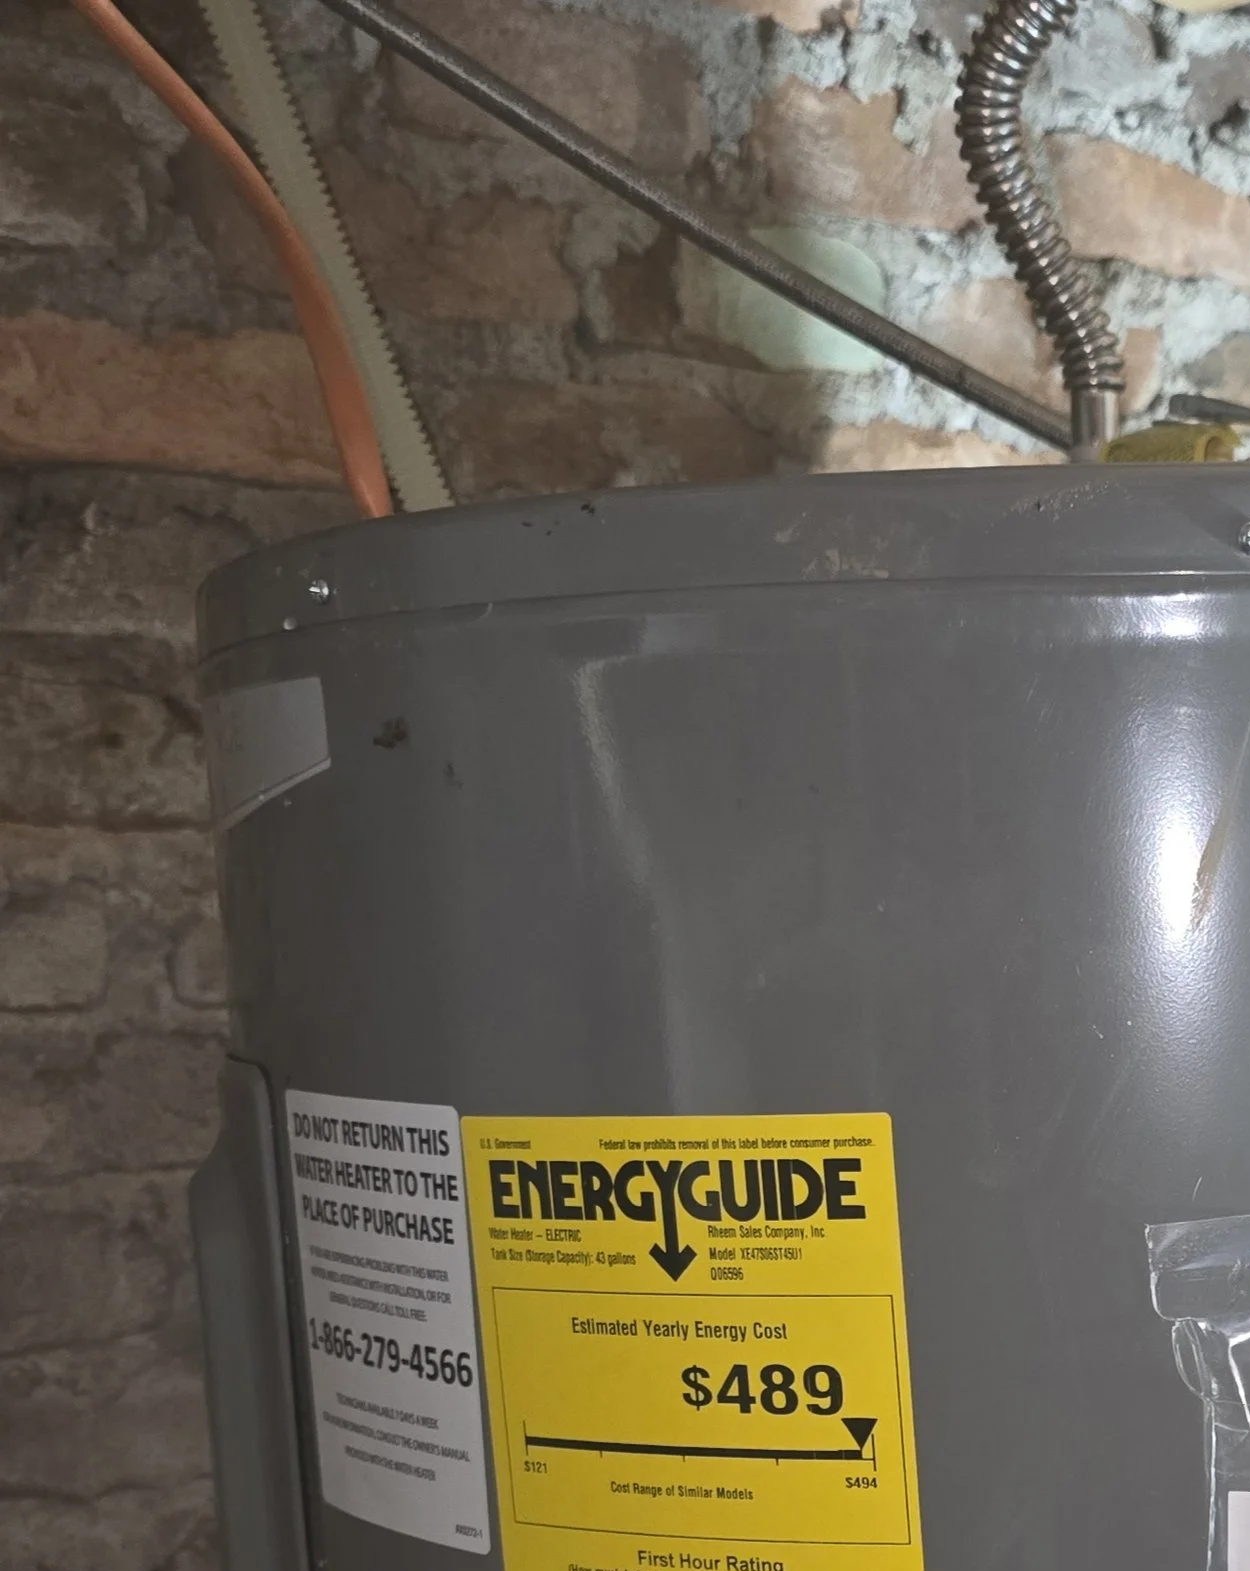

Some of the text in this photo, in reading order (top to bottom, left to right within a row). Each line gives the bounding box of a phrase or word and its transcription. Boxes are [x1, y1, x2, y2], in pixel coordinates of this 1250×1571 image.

[293, 1113, 449, 1157] DO NOT RETURN THIS
[599, 1139, 625, 1150] Federal
[628, 1139, 641, 1149] law
[644, 1139, 676, 1150] prohibits
[678, 1139, 709, 1150] removal
[712, 1139, 720, 1149] of
[722, 1139, 736, 1148] this
[739, 1138, 758, 1149] label
[761, 1139, 788, 1148] before
[790, 1138, 830, 1148] consumer
[295, 1153, 458, 1201] WATER HEATER TO THE
[489, 1158, 866, 1226] ENERGYGUIDE
[302, 1195, 454, 1244] PLACE OF PURCHASE
[708, 1225, 737, 1238] Rheem
[739, 1225, 762, 1238] Sales
[491, 1248, 506, 1260] Tank
[508, 1249, 523, 1261] Size
[525, 1249, 555, 1264] (Storage
[608, 1252, 636, 1266] gallons
[710, 1248, 736, 1260] Model
[572, 1317, 787, 1342] Estimated Yearly Energy Cost
[309, 1317, 473, 1387] 1-866-279-4566
[681, 1363, 844, 1416] $489
[524, 1461, 548, 1474] $121
[611, 1481, 754, 1501] Cost Range of Similar Models
[845, 1476, 877, 1489] $494
[638, 1550, 675, 1568] First
[680, 1554, 720, 1570] Hour
